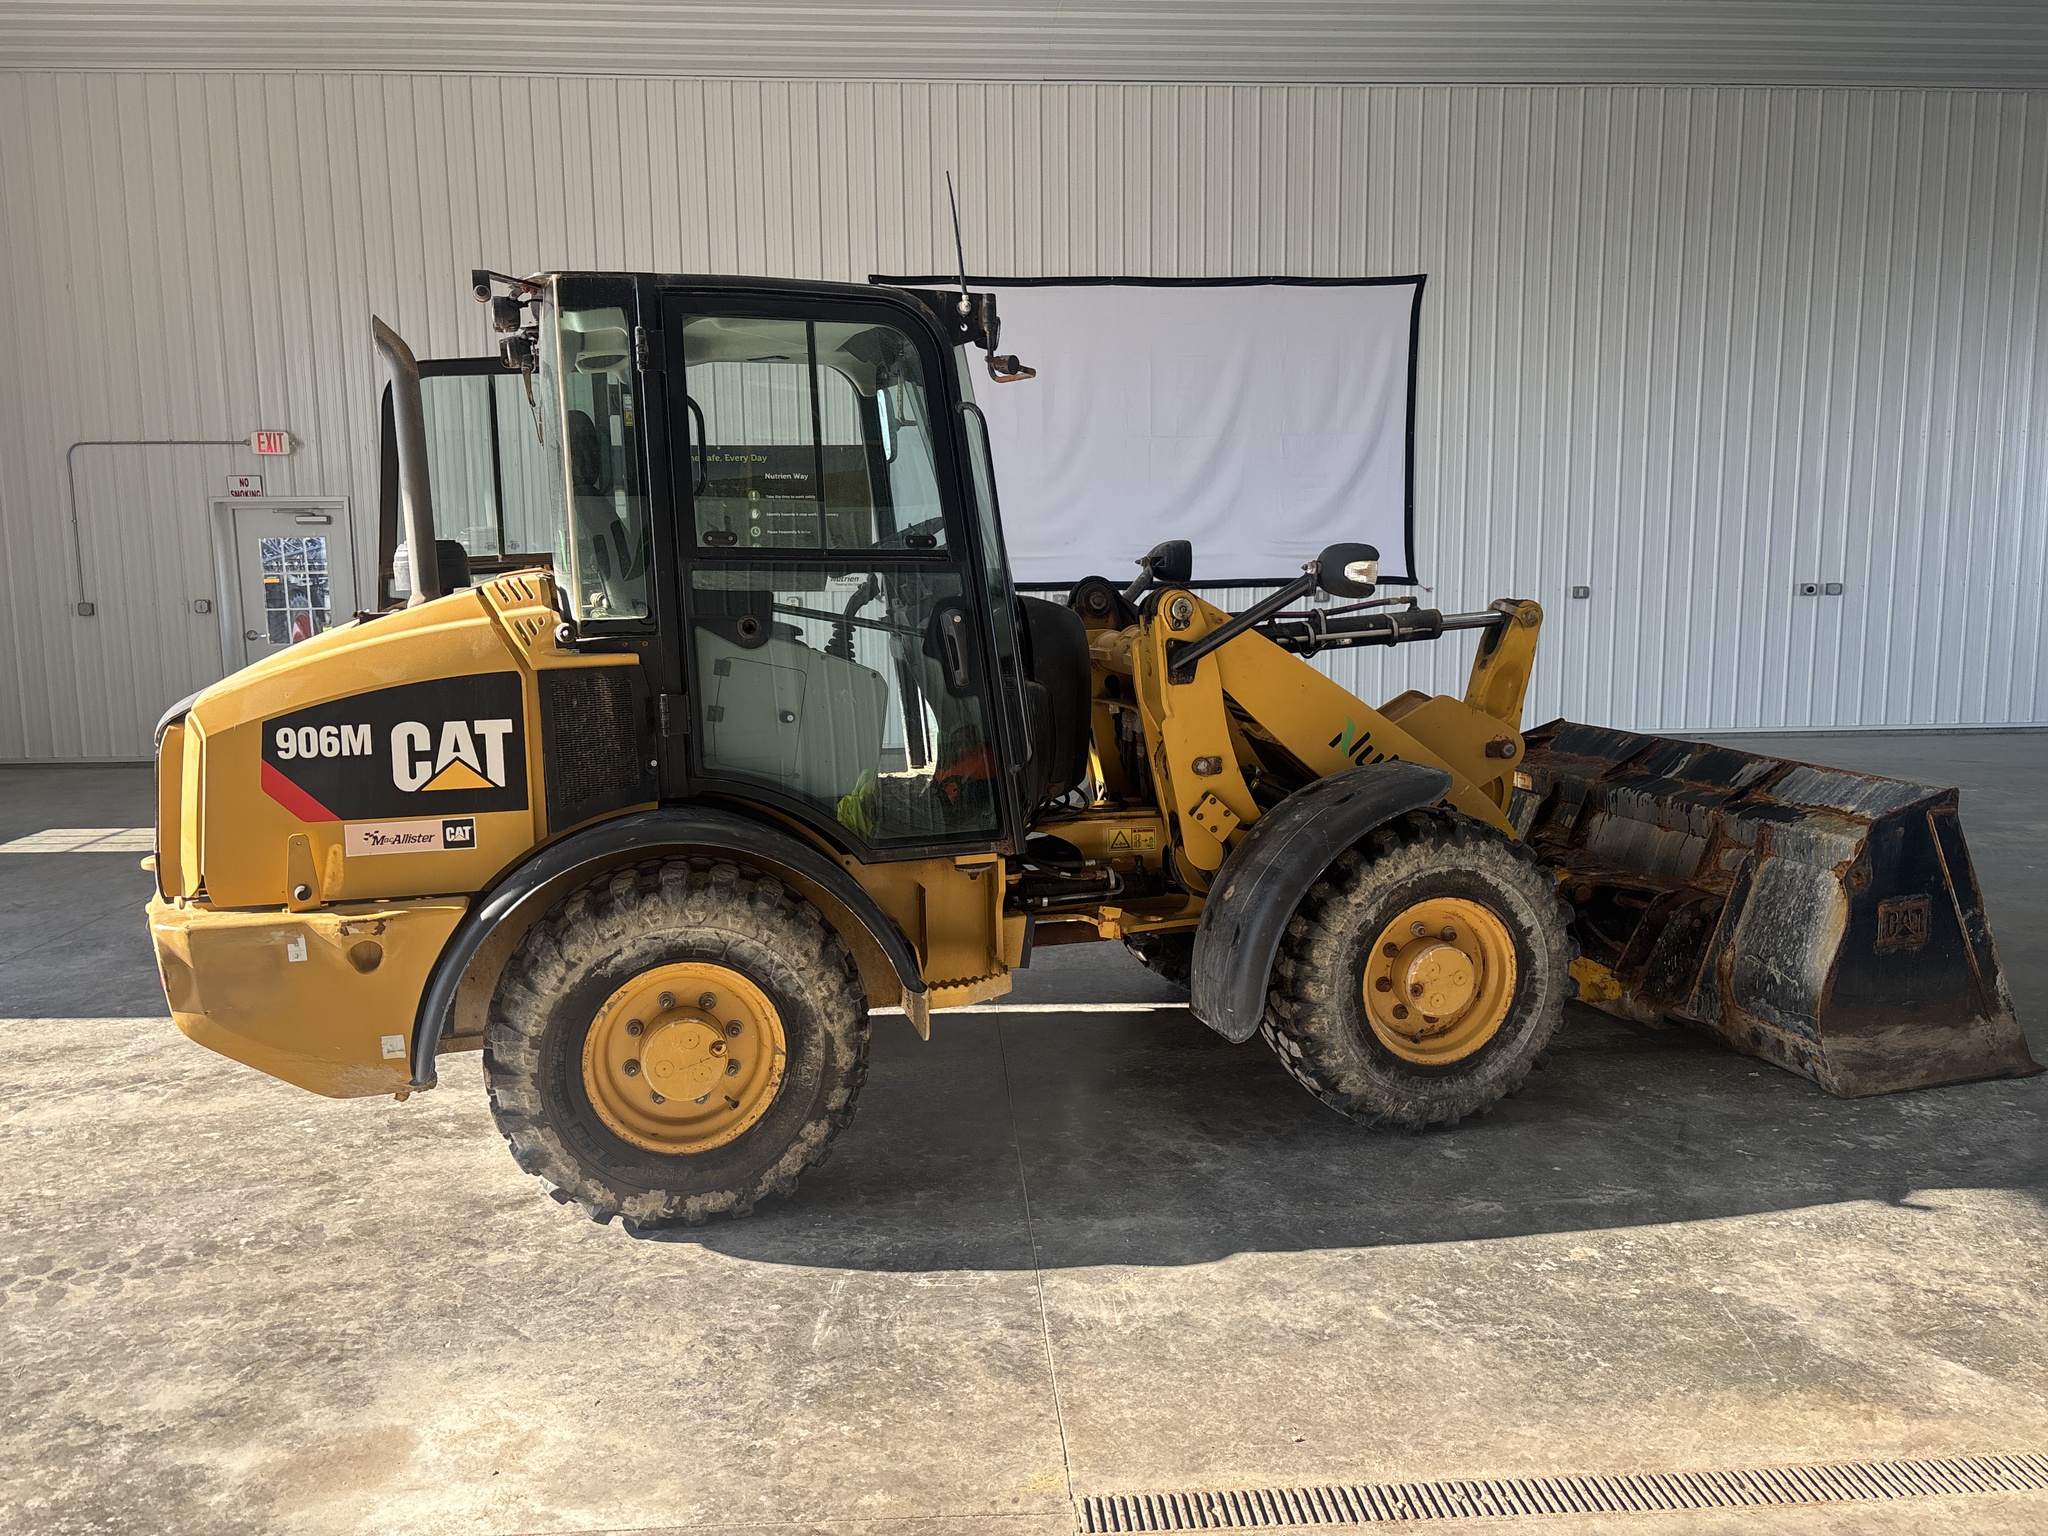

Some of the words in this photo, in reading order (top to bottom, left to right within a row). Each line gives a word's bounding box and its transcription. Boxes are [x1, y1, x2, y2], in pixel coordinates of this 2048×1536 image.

[257, 433, 283, 453] EXIT
[707, 454, 722, 463] afe,
[725, 454, 748, 463] Every
[751, 454, 767, 463] Day
[239, 478, 249, 487] NO
[275, 724, 373, 759] 906M
[391, 719, 513, 792] CAT
[371, 833, 435, 846] MacAllister
[445, 826, 472, 842] CAT
